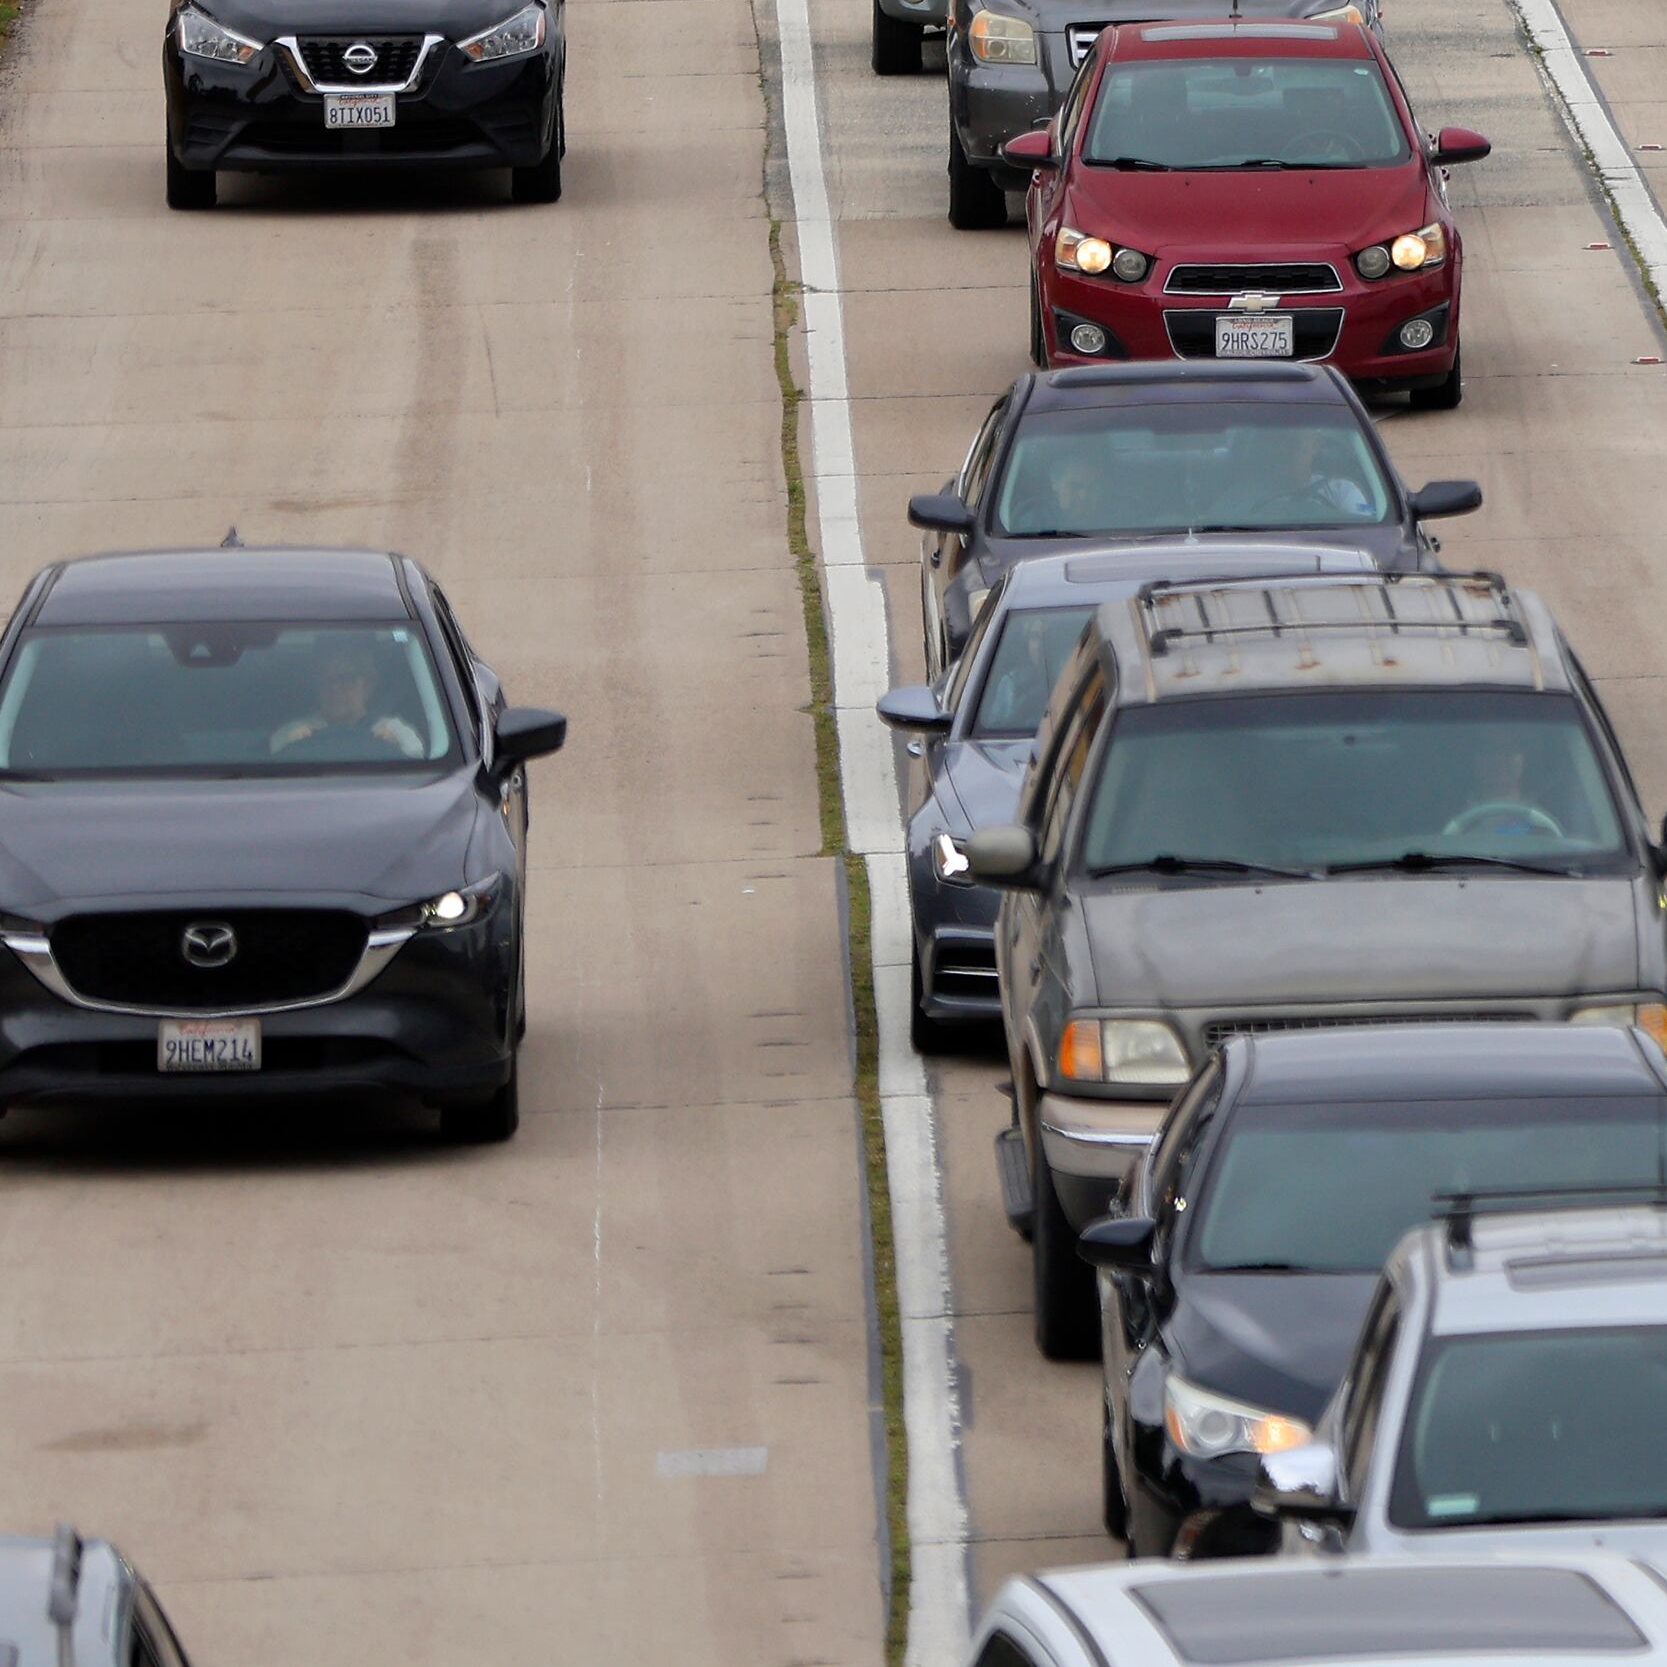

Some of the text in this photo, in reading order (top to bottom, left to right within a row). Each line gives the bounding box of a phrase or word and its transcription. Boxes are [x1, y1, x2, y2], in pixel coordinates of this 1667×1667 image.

[329, 107, 391, 124] 8TIX051
[1221, 332, 1288, 350] 9HRS275
[165, 1037, 254, 1065] 9HEM214
